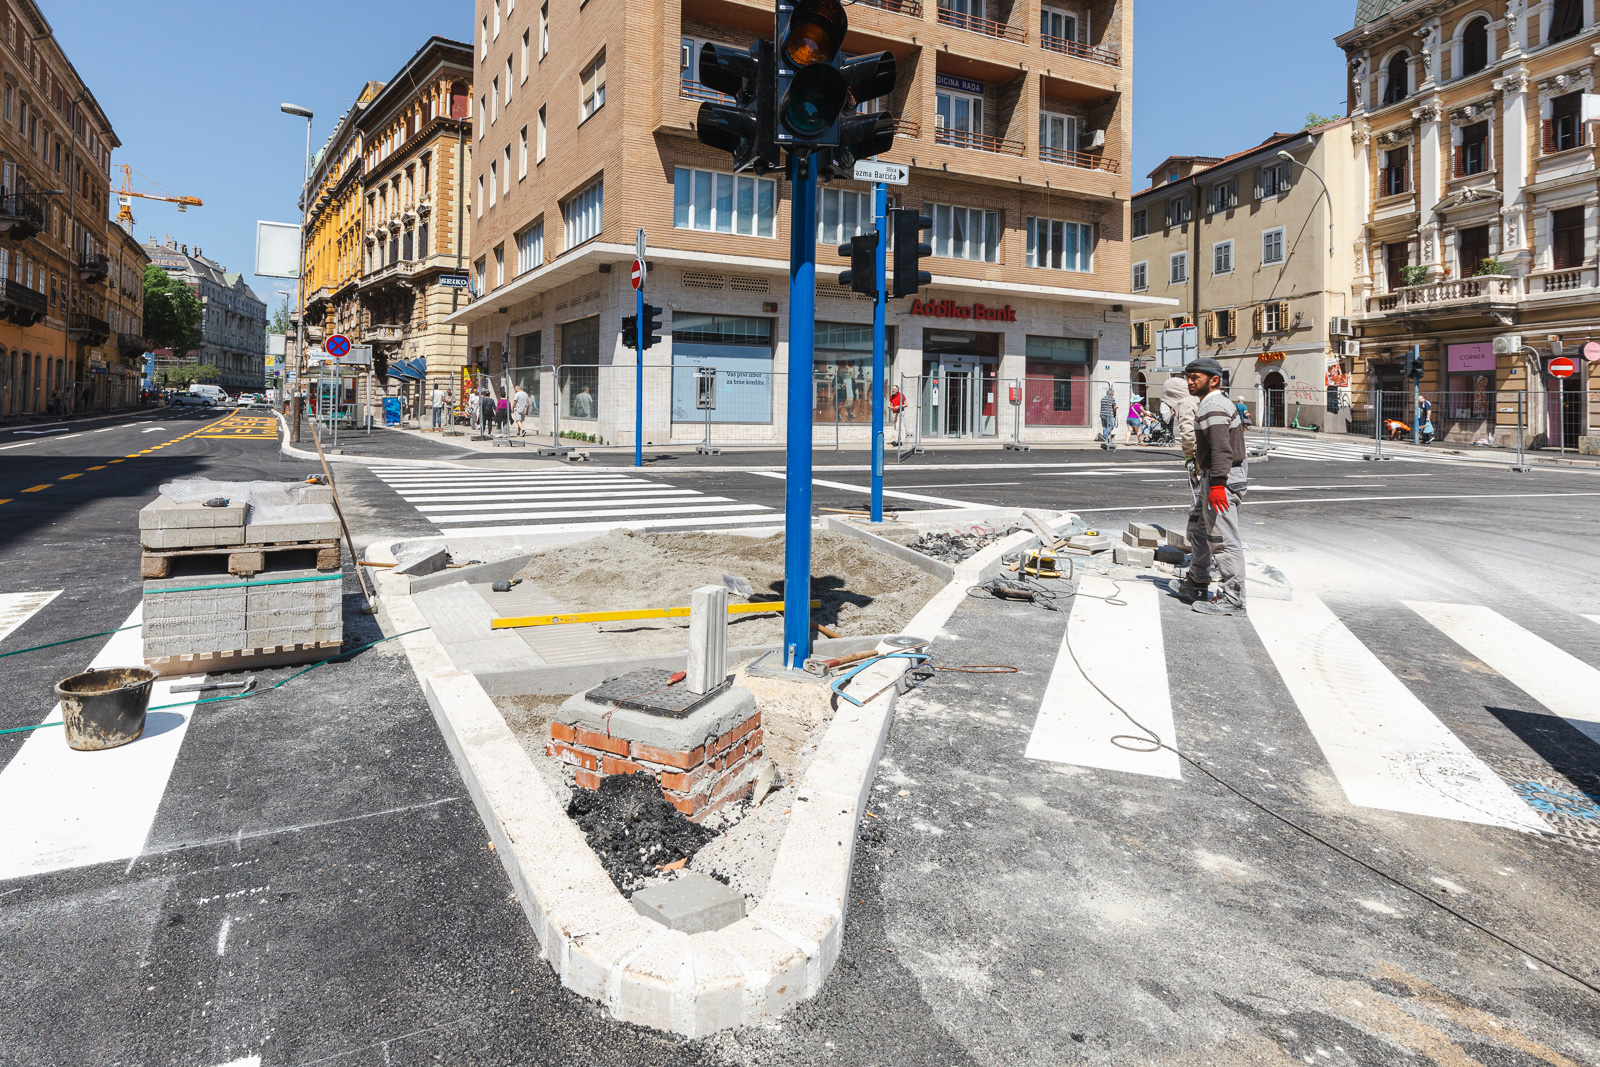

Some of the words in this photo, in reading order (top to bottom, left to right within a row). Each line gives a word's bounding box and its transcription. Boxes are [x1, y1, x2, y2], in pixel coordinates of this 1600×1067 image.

[936, 76, 960, 88] DICINA
[962, 81, 981, 92] RADA
[874, 170, 897, 181] Barčića
[441, 277, 467, 286] SEIKO
[910, 298, 973, 319] Addiko
[974, 303, 1017, 322] Bank
[1459, 353, 1486, 361] CORNER
[737, 371, 748, 379] prvi
